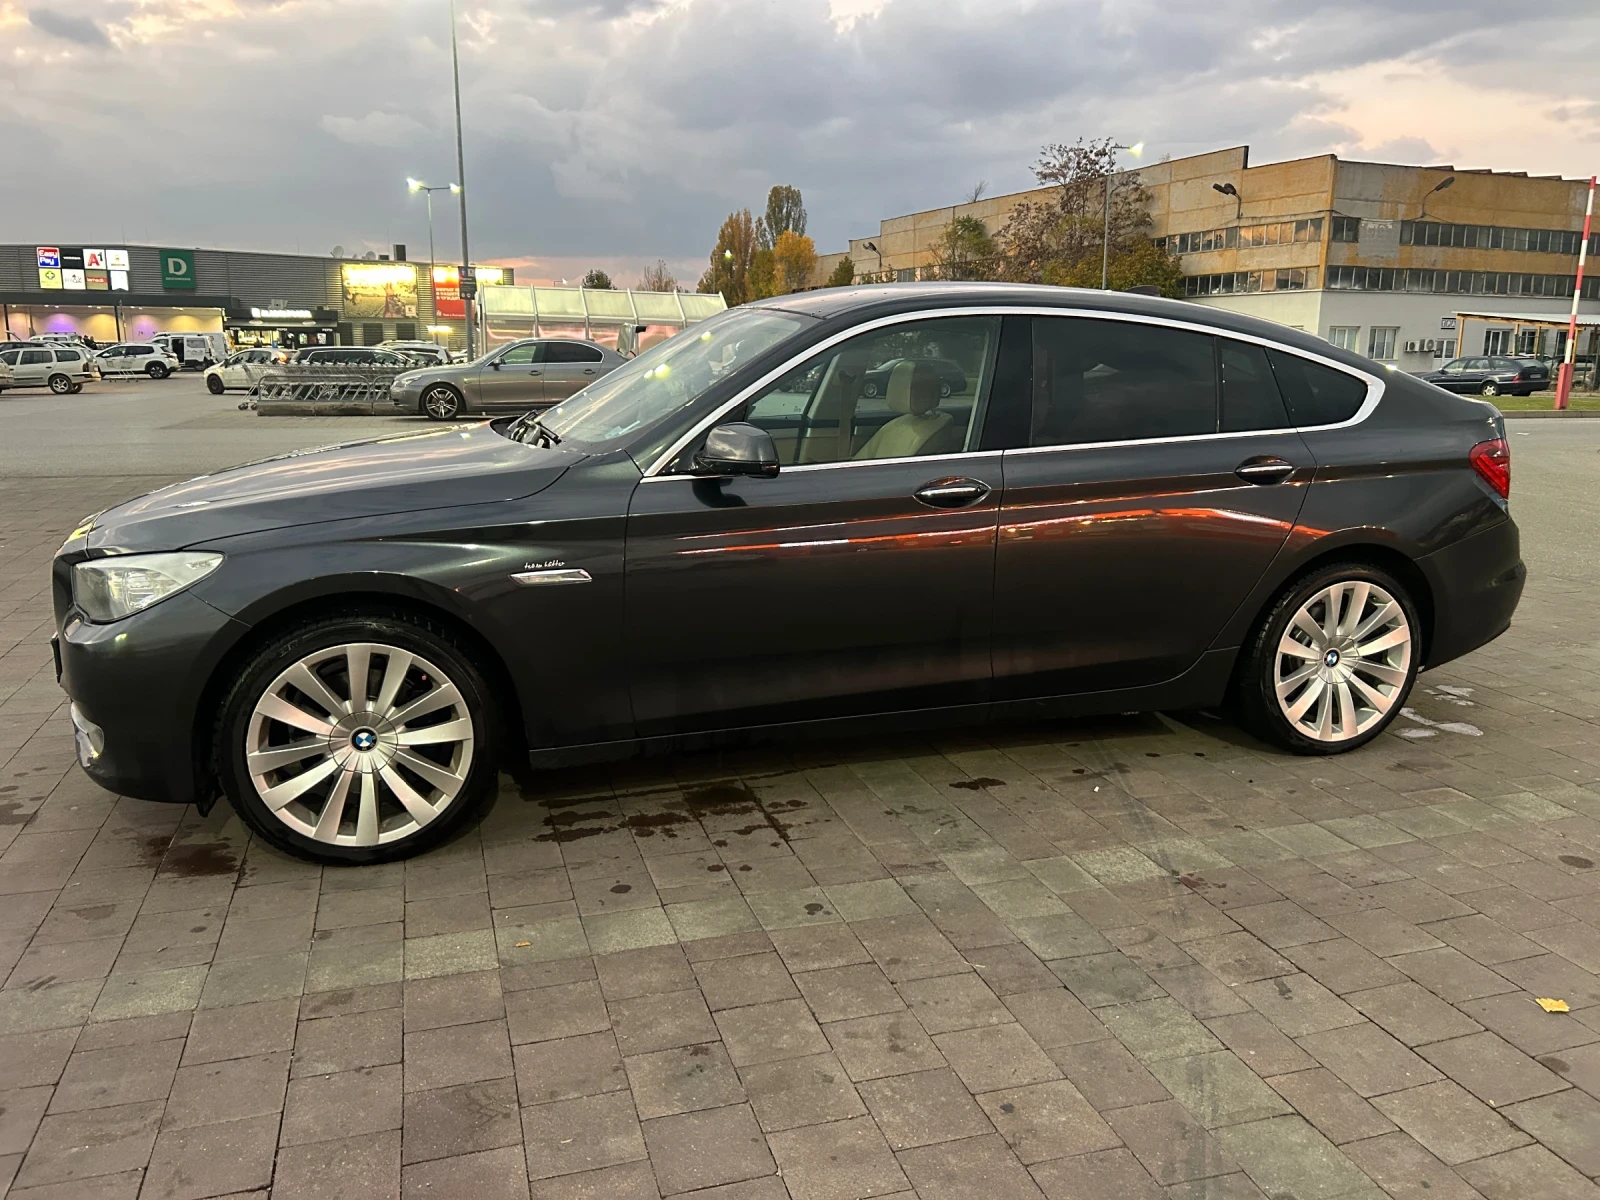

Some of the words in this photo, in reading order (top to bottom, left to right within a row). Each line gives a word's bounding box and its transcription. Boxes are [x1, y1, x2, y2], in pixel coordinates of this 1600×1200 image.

[38, 249, 58, 259] Easy
[87, 251, 103, 267] A1
[39, 257, 55, 265] Pay
[167, 257, 187, 275] D
